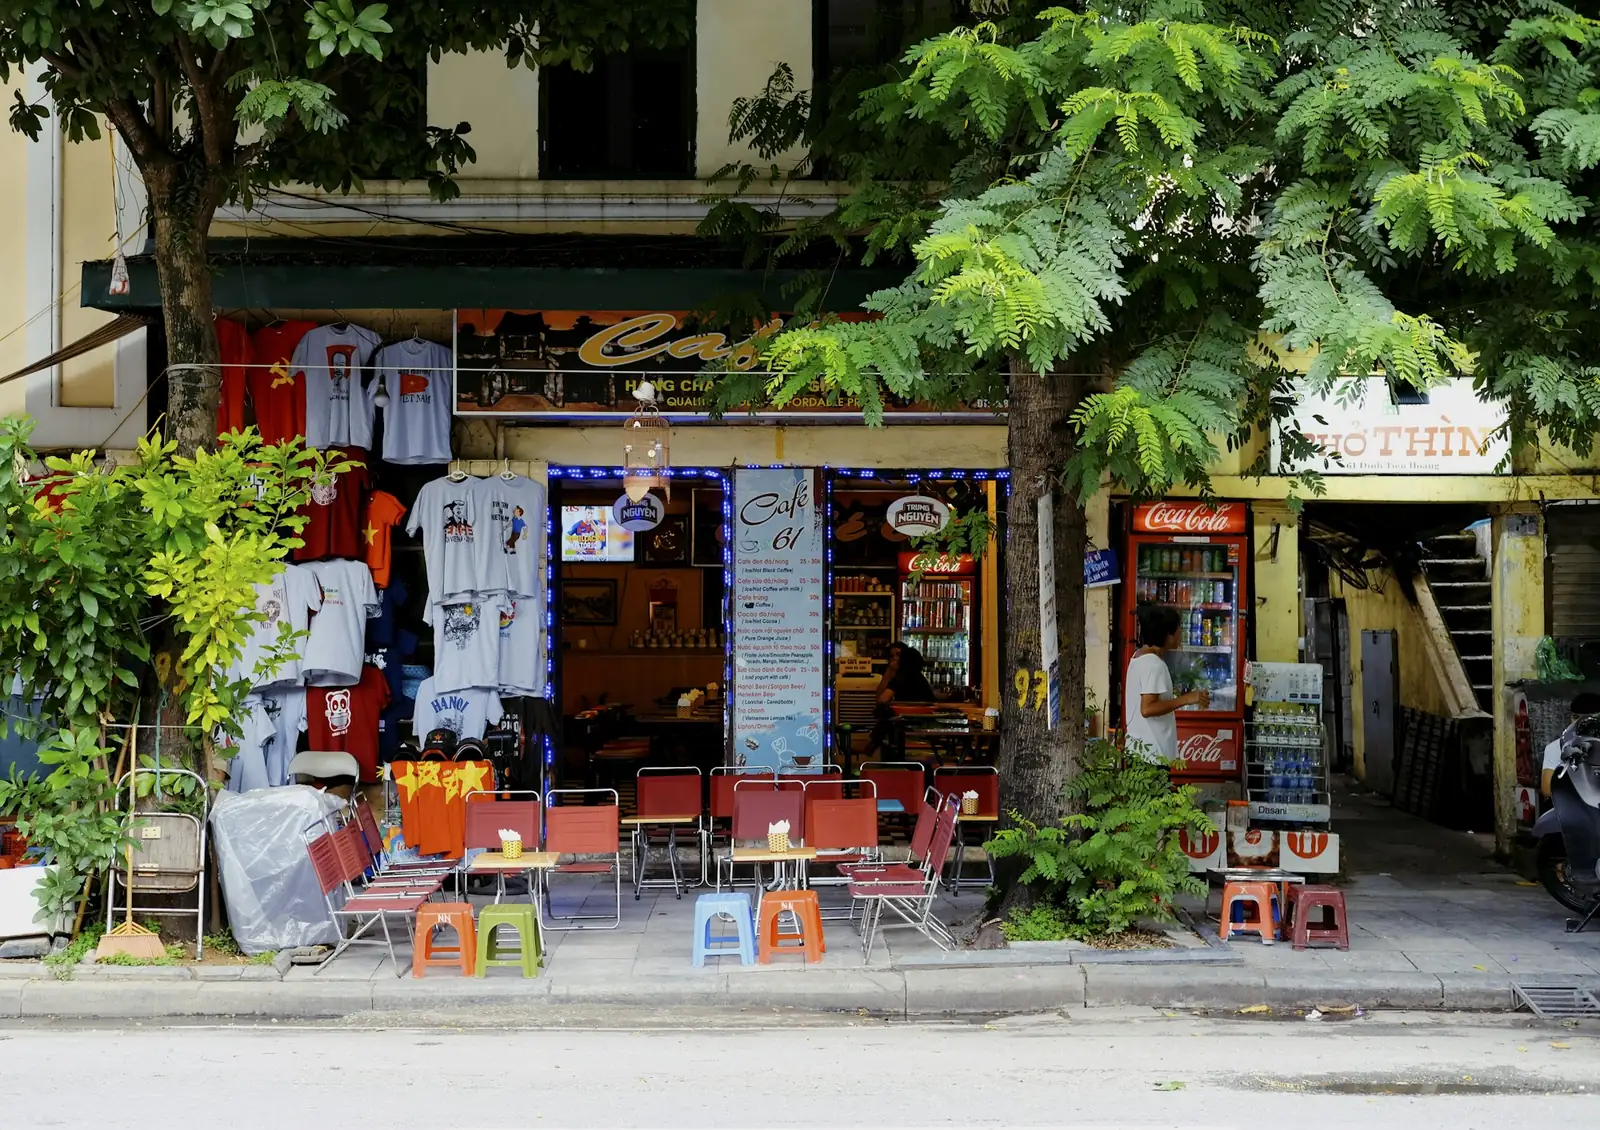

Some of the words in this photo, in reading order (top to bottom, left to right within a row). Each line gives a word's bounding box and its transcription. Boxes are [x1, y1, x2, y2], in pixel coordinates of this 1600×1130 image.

[578, 313, 806, 372] Caf
[740, 479, 810, 526] Café
[907, 504, 930, 512] TRUNG
[1145, 503, 1231, 532] Coca-Cola
[772, 527, 805, 551] 61
[430, 696, 470, 713] HANOI
[1258, 805, 1288, 815] Dasani
